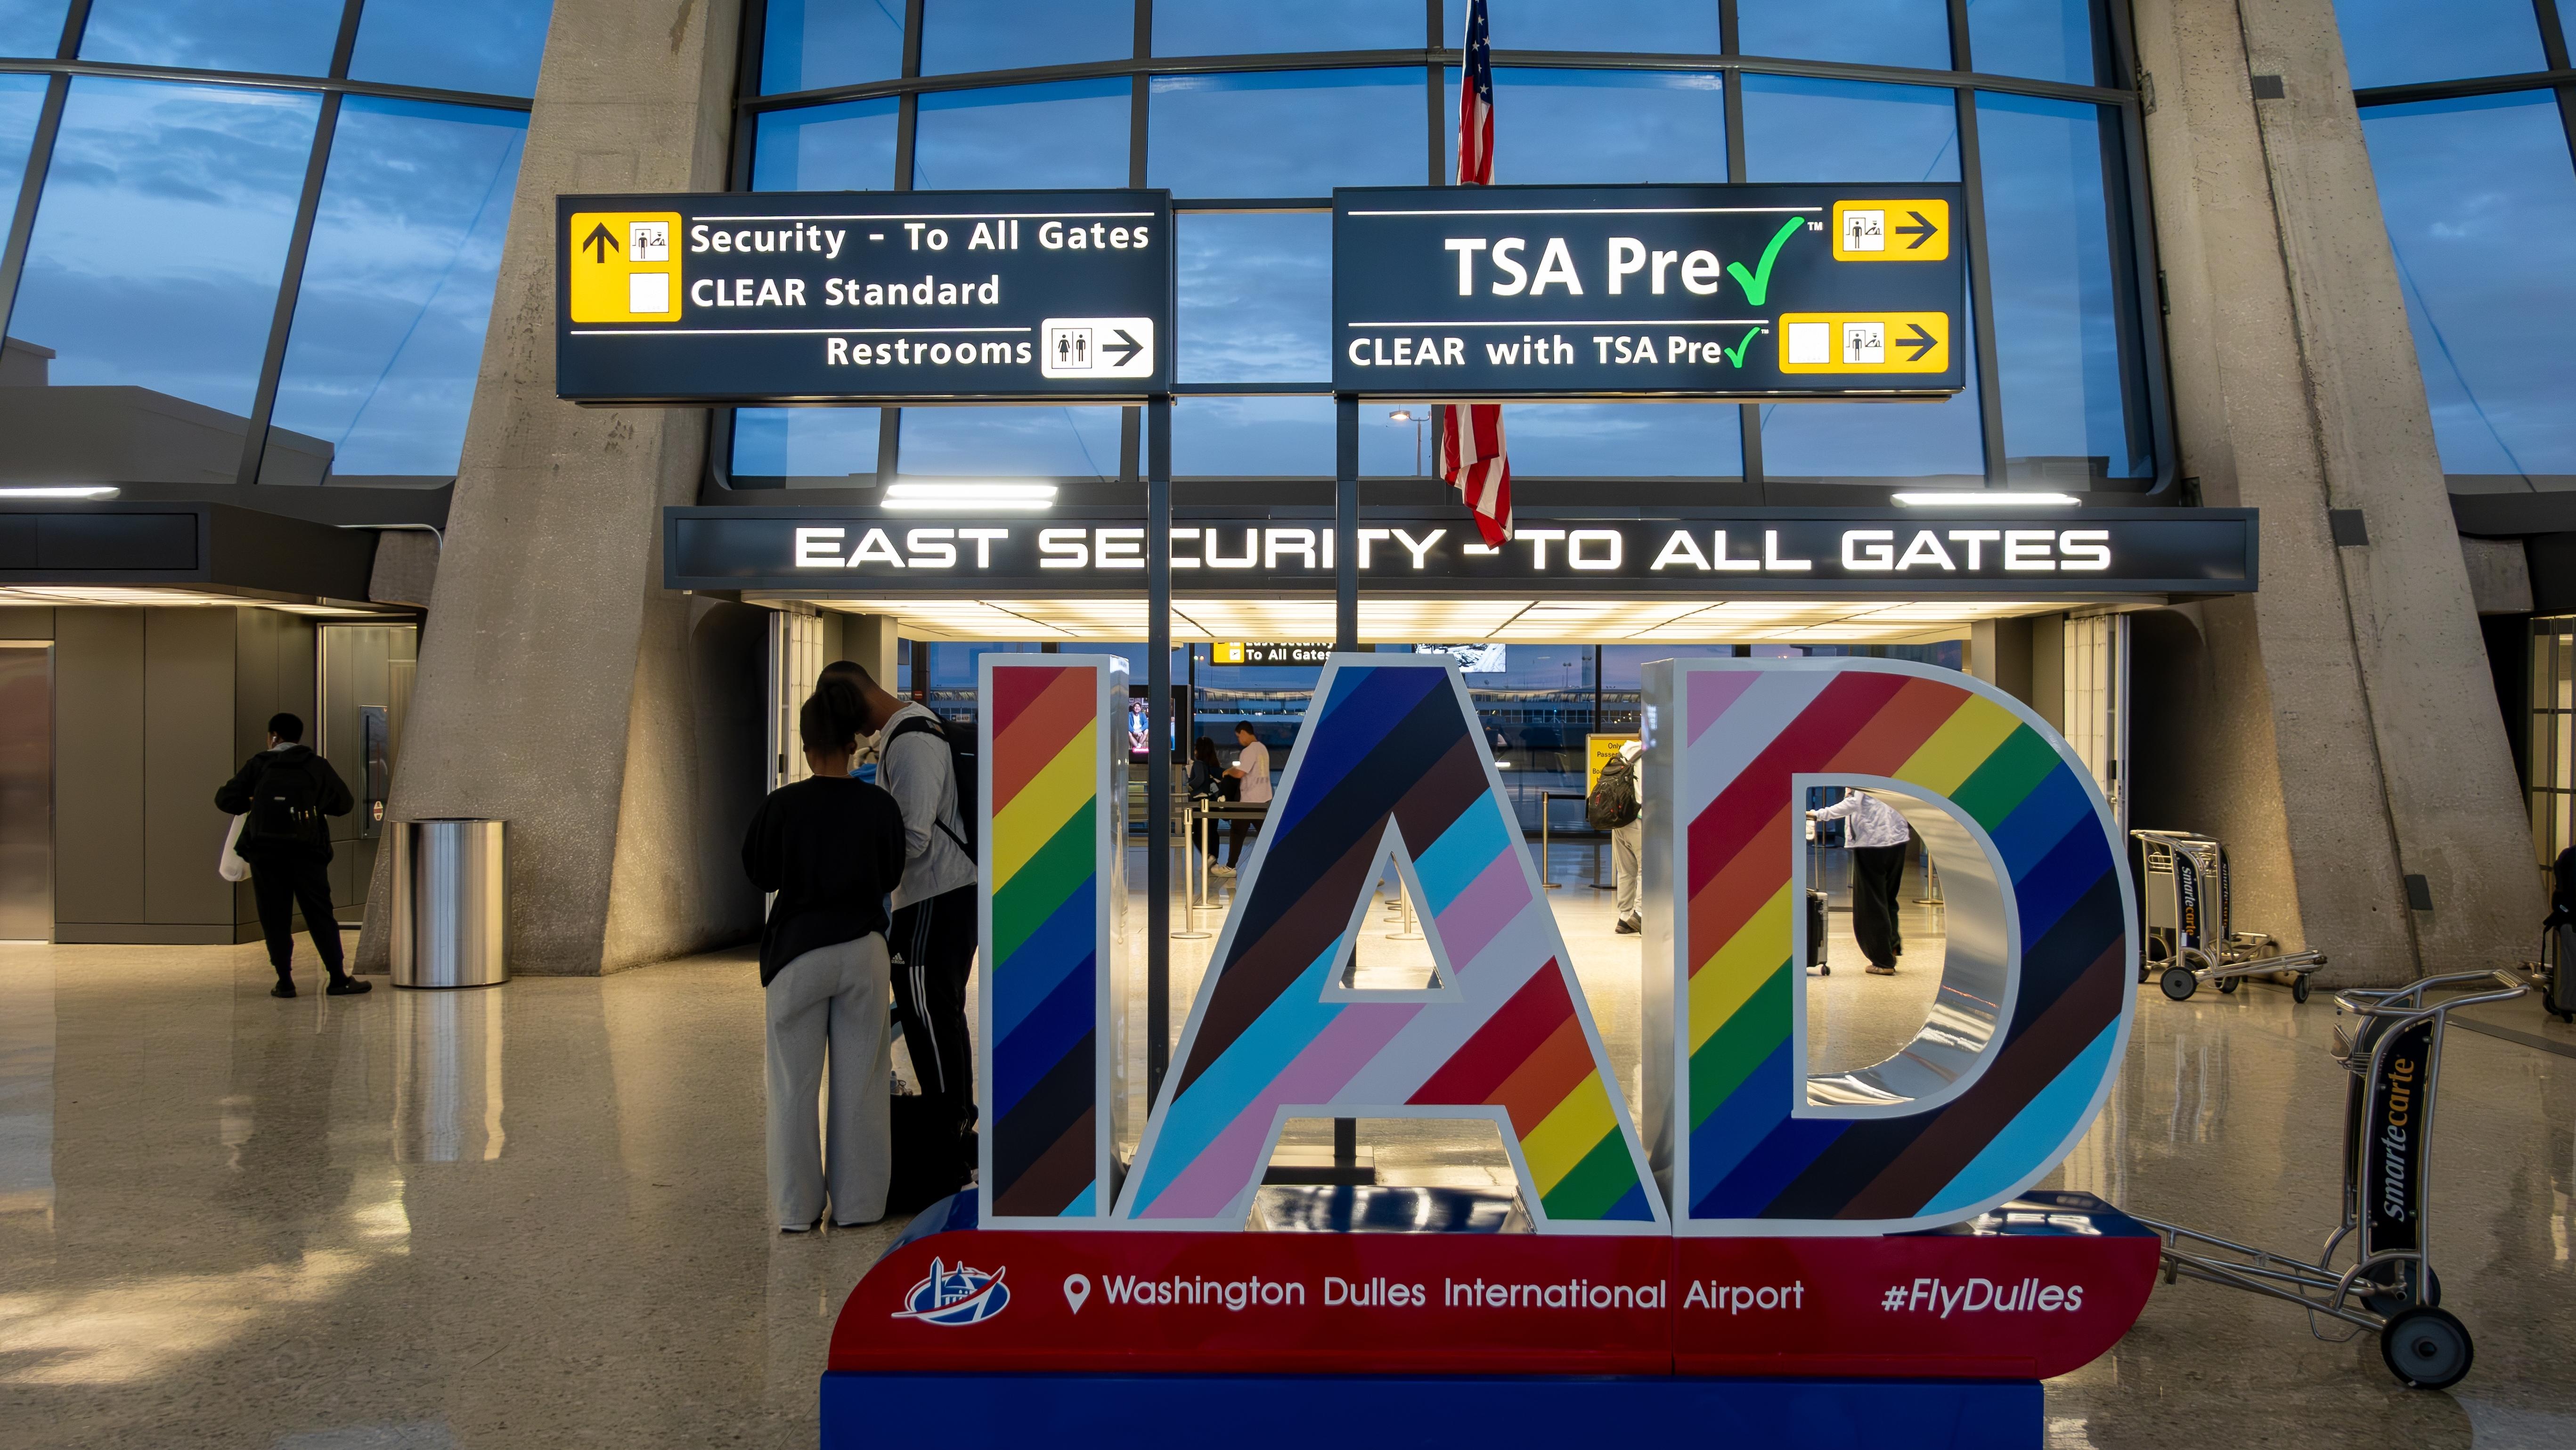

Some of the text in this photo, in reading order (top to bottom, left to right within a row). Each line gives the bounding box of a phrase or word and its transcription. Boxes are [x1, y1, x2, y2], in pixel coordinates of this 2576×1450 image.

[691, 222, 846, 259] Security
[904, 223, 948, 251] To
[968, 220, 1018, 250] All
[1039, 221, 1149, 250] Gates
[1444, 237, 1583, 296] TSA
[1608, 237, 1720, 295] Pre
[691, 274, 999, 307] CLEAR Standard
[828, 337, 1032, 365] Restrooms
[1348, 337, 1465, 366] CLEAR
[1485, 334, 1573, 365] with
[1593, 336, 1658, 364] TSA
[1668, 336, 1721, 364] Pre
[795, 528, 1009, 568] EAST
[1514, 529, 1622, 570] TO
[1650, 530, 1811, 570] ALL
[1842, 530, 2111, 570] GATES
[1246, 649, 1263, 660] To
[1268, 648, 1287, 660] All
[2182, 866, 2196, 936] smartecarte
[978, 653, 2139, 1238] IAD
[2384, 1058, 2414, 1222] smartecarte
[1102, 1275, 2083, 1319] Washington Dulles International Airport #FlyDulles
